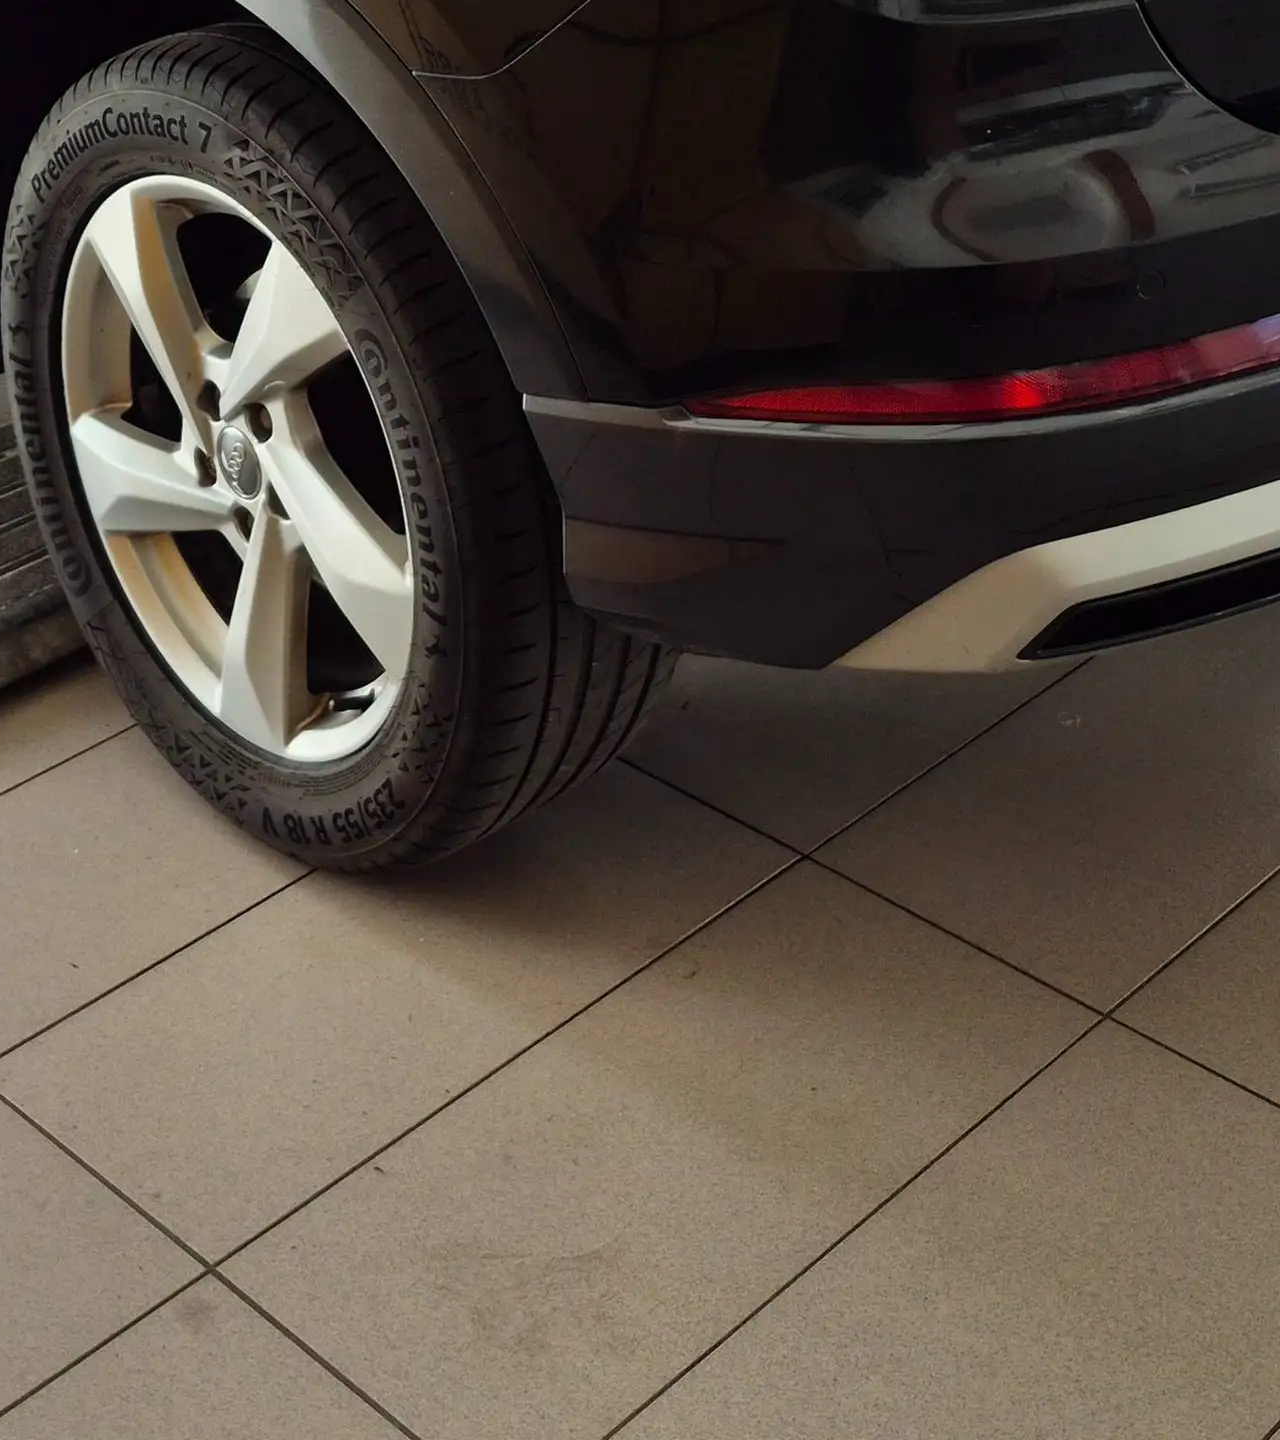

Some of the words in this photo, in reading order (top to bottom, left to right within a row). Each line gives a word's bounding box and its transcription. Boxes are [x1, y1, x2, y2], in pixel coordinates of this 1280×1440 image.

[31, 106, 189, 203] PremiumContact
[197, 122, 213, 153] 7
[9, 352, 93, 598] Continental
[354, 327, 450, 625] Continental
[262, 806, 280, 839] V
[332, 777, 405, 843] 235/55
